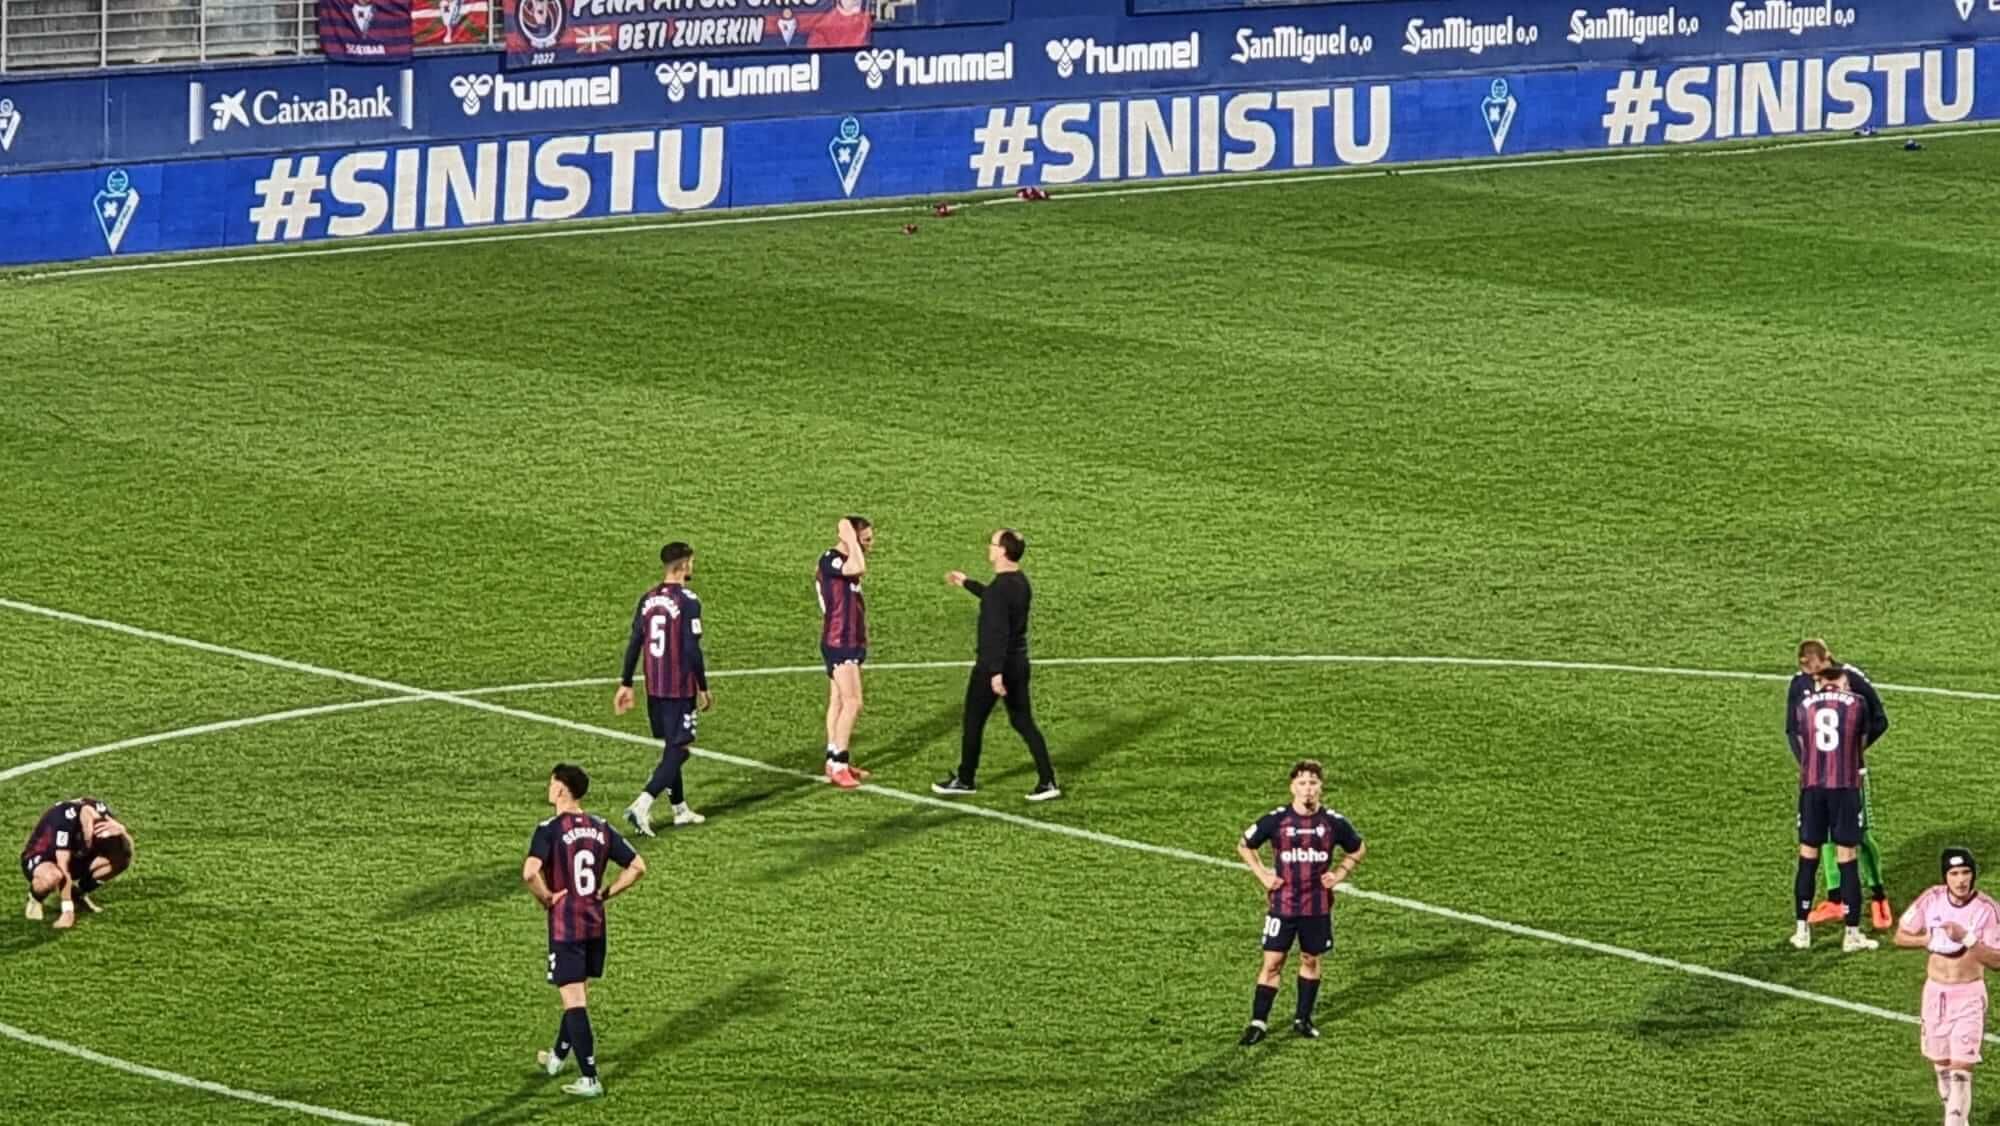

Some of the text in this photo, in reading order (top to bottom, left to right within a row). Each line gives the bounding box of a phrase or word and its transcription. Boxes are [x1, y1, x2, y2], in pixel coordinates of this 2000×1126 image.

[618, 17, 764, 51] BETI ZUREKIN
[1402, 16, 1513, 54] SanMiguel
[1567, 7, 1674, 44] SanMiguel
[1726, 0, 1831, 35] SanMiguel
[896, 42, 1013, 86] hummel
[1086, 31, 1199, 74] hummel
[1231, 25, 1346, 64] SanMiguel
[494, 66, 619, 112] hummel
[698, 53, 820, 98] hummel
[1602, 48, 1976, 145] #SINISTU
[253, 84, 393, 125] CaixaBank
[969, 85, 1391, 188] #SINISTU
[249, 126, 725, 241] #SINISTU
[649, 615, 667, 657] 5
[1815, 708, 1839, 751] 8
[574, 849, 596, 896] 6
